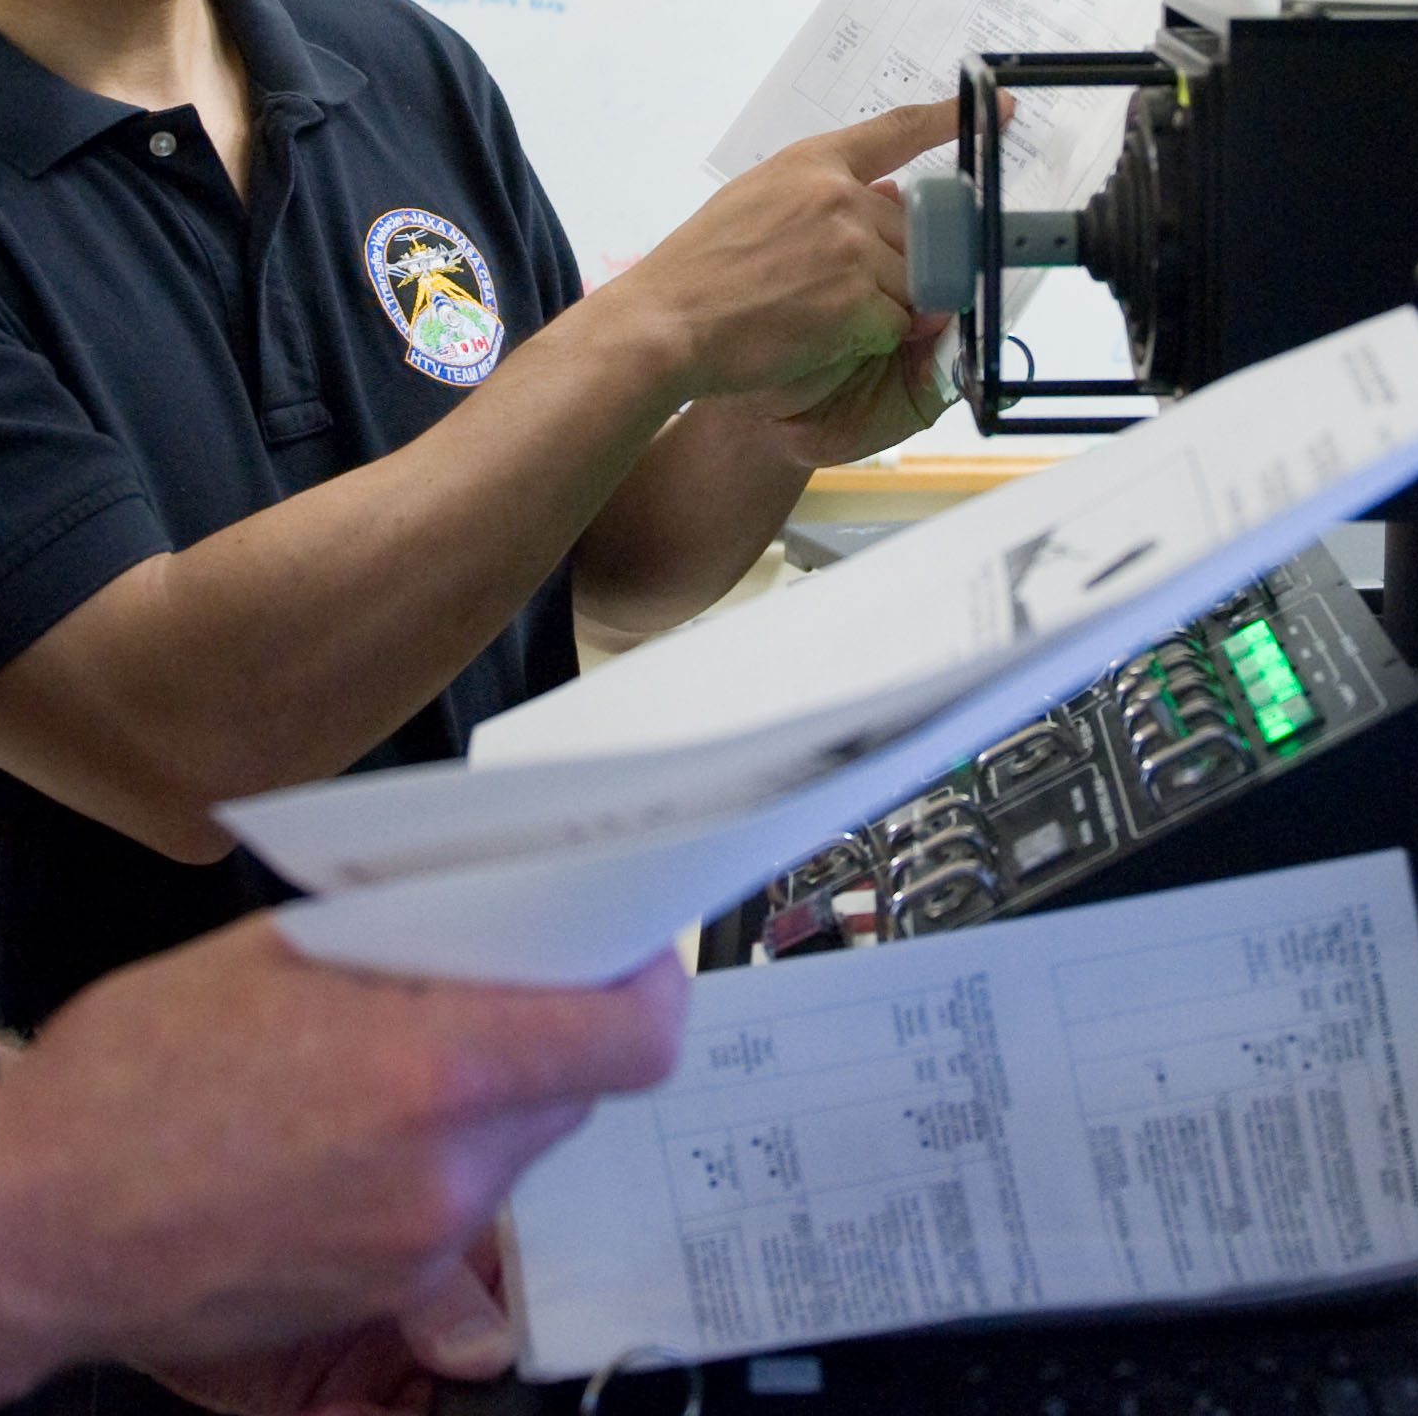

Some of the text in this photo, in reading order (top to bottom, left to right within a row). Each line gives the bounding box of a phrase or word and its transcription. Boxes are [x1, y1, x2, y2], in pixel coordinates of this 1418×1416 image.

[409, 214, 494, 302] JAXA NASA CSA
[410, 349, 442, 376] HTV
[444, 365, 479, 383] TEAM
